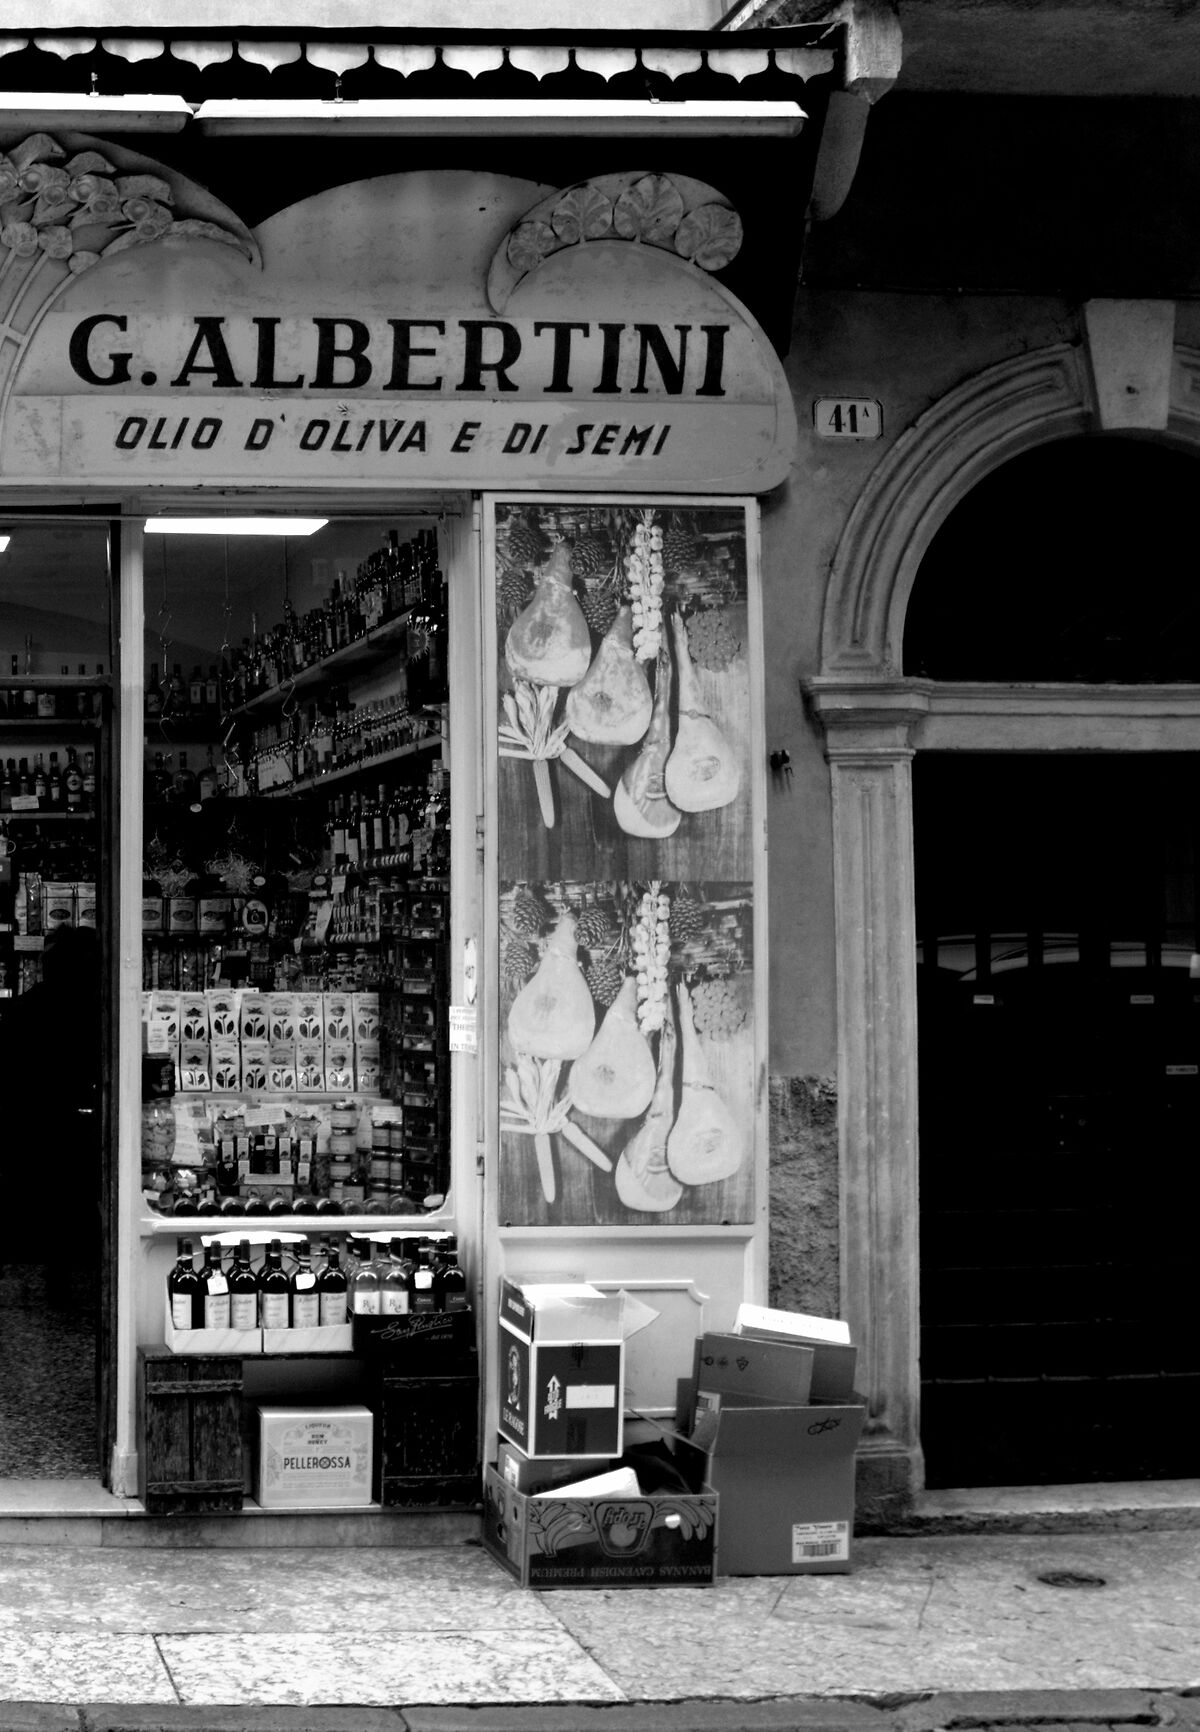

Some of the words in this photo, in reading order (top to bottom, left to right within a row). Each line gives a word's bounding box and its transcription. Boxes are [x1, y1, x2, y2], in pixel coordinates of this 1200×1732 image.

[115, 416, 222, 450] OLIO
[300, 419, 426, 453] OLIVA
[452, 422, 482, 453] E
[503, 423, 549, 454] DI
[567, 424, 671, 456] SEMI
[284, 1456, 351, 1470] PELLEROSSA
[531, 1567, 585, 1579] PREMIUM
[590, 1566, 654, 1578] CAVENDISH
[659, 1564, 712, 1577] BANANAS
